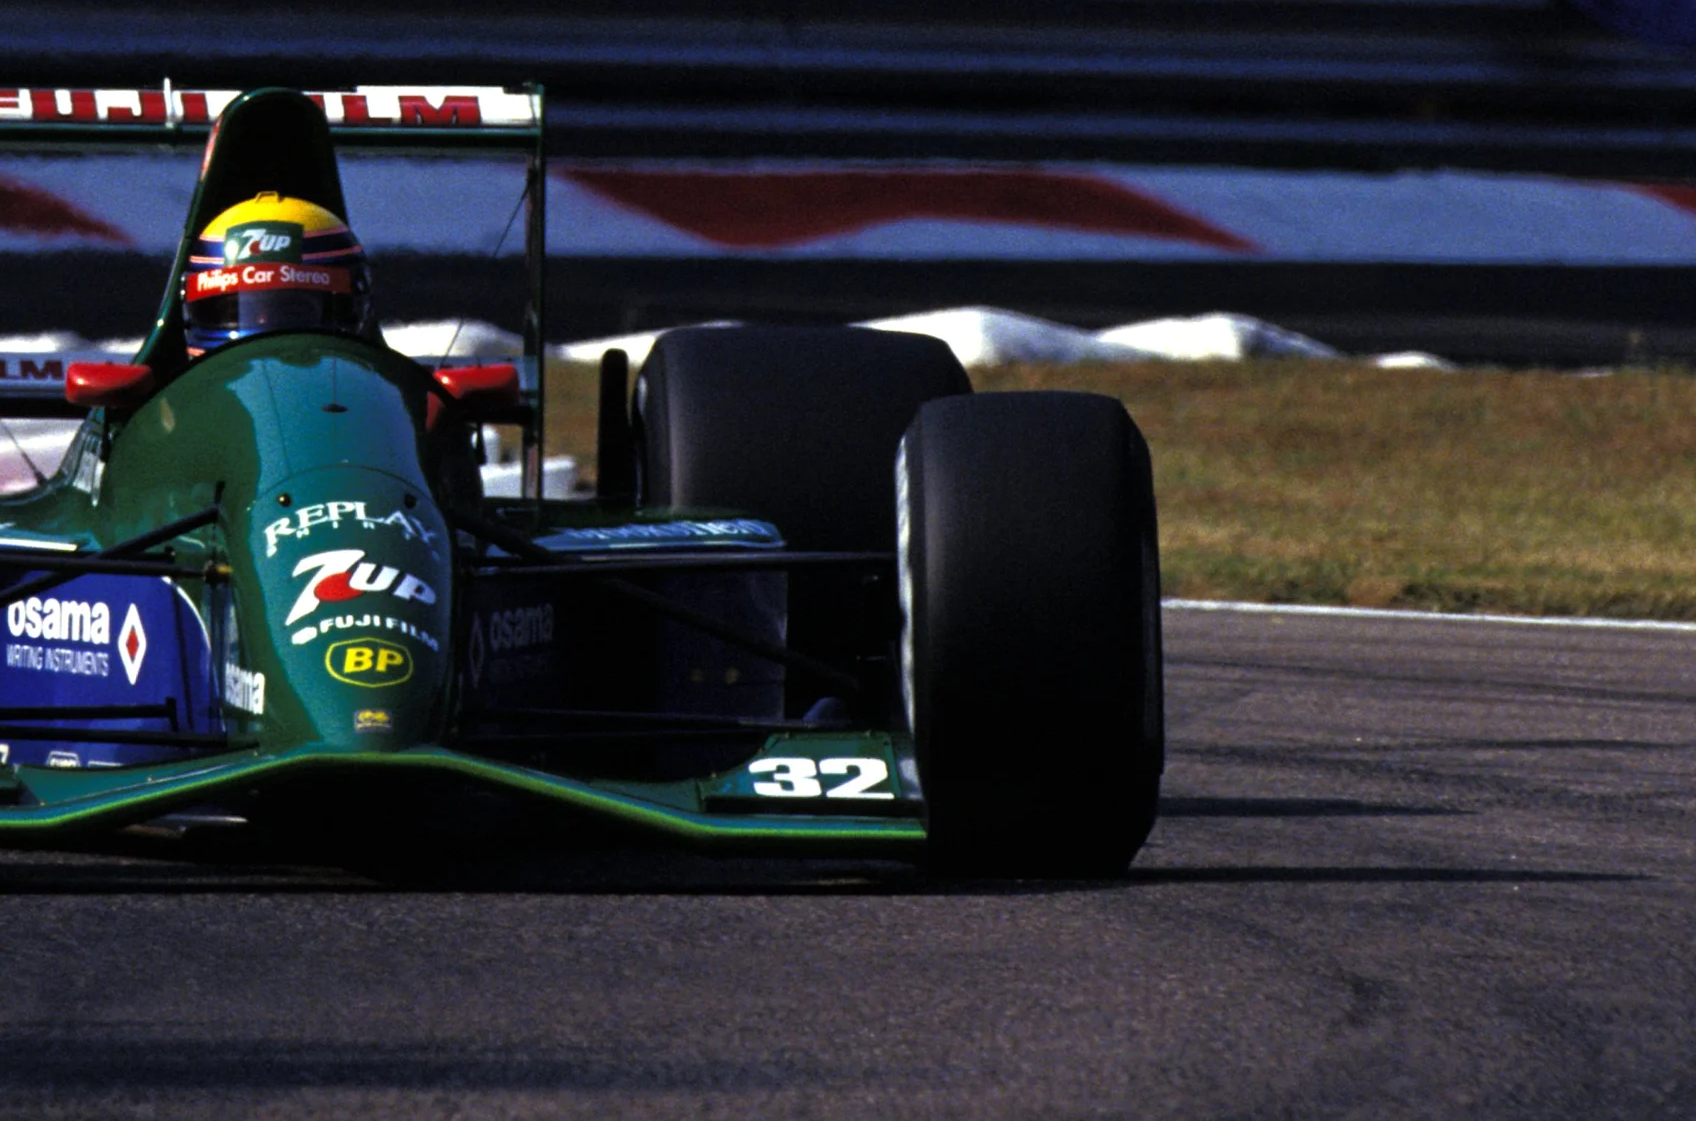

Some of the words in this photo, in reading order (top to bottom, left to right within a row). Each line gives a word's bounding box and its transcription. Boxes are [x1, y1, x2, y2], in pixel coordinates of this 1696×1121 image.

[197, 266, 239, 292] Philips
[242, 266, 274, 284] Car
[280, 265, 331, 285] Stereo
[264, 501, 437, 545] REPLAY
[6, 596, 111, 646] osama
[488, 602, 554, 654] osama
[6, 643, 44, 671] WRITING
[44, 649, 109, 677] INSTRUMENTS
[343, 646, 404, 675] BP
[747, 756, 896, 800] 32
